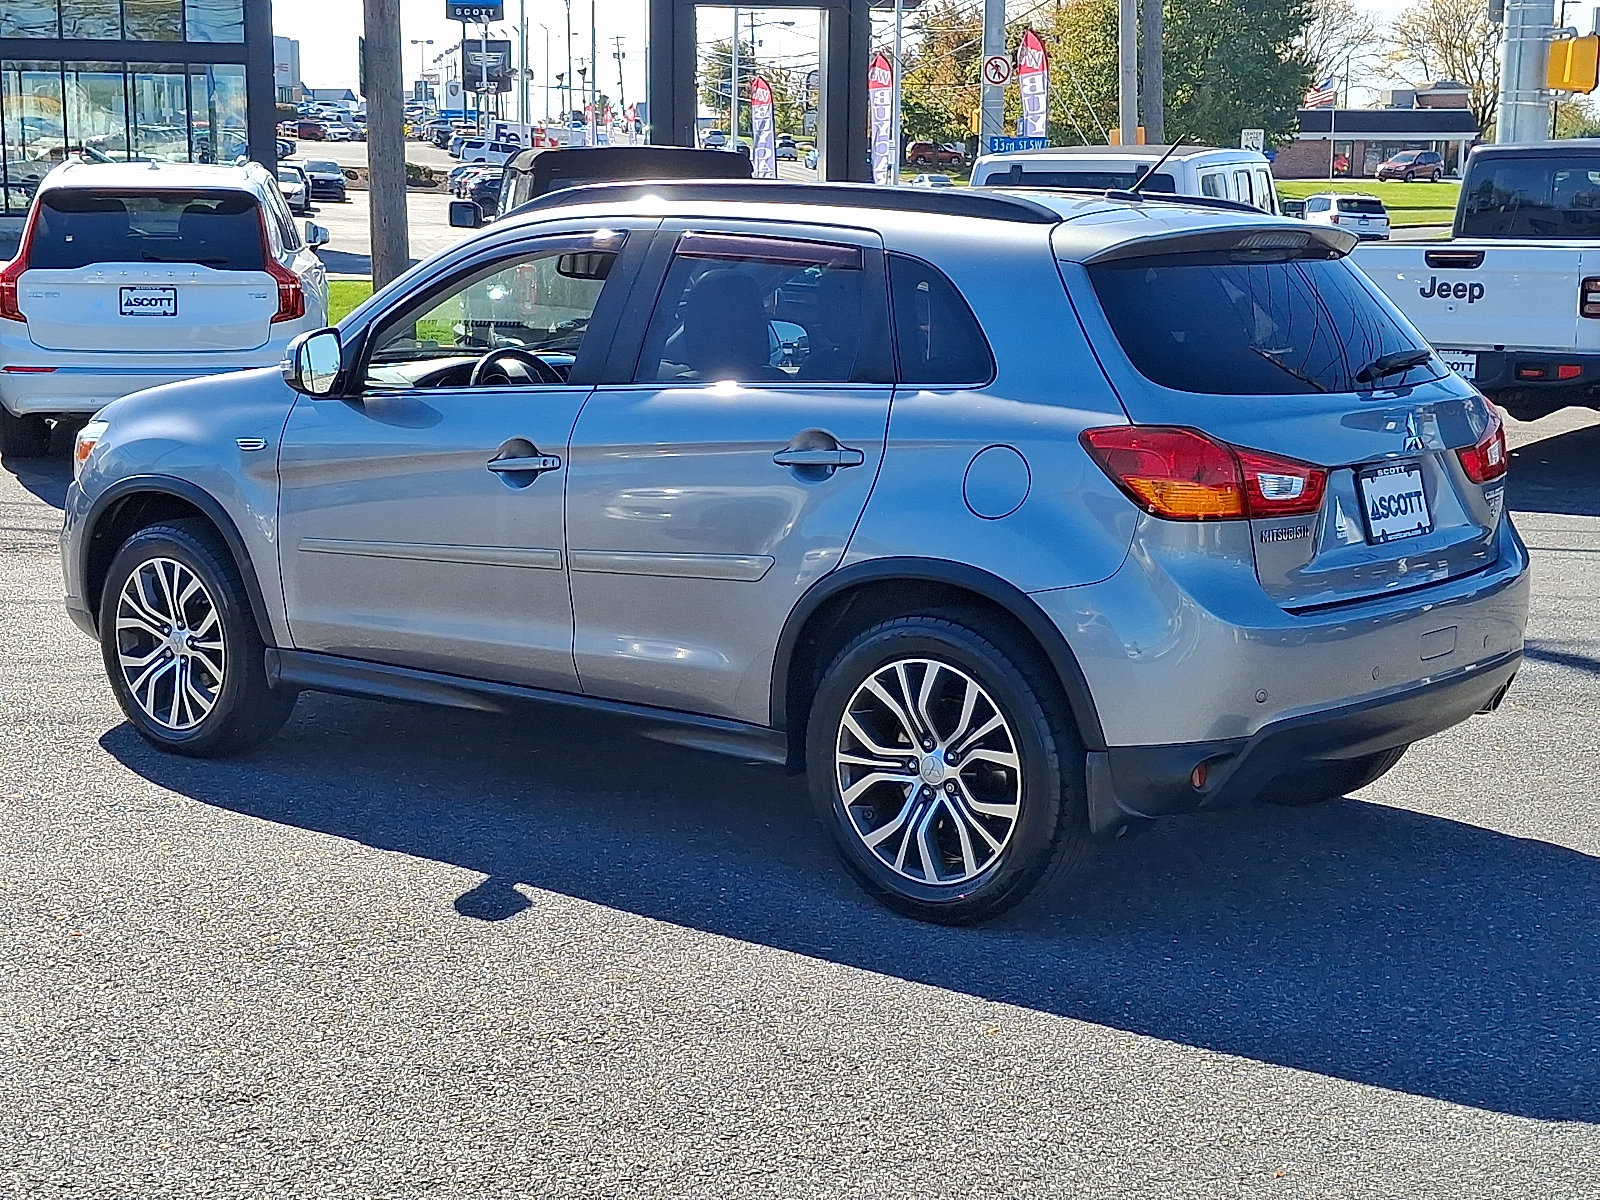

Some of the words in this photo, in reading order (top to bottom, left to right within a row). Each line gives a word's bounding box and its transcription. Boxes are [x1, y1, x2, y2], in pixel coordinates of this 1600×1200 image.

[455, 8, 494, 16] SCOTT
[1420, 276, 1485, 304] Jeep
[133, 297, 173, 306] SCOTT
[1377, 466, 1405, 476] SCOTT
[1381, 491, 1423, 519] SCOTT
